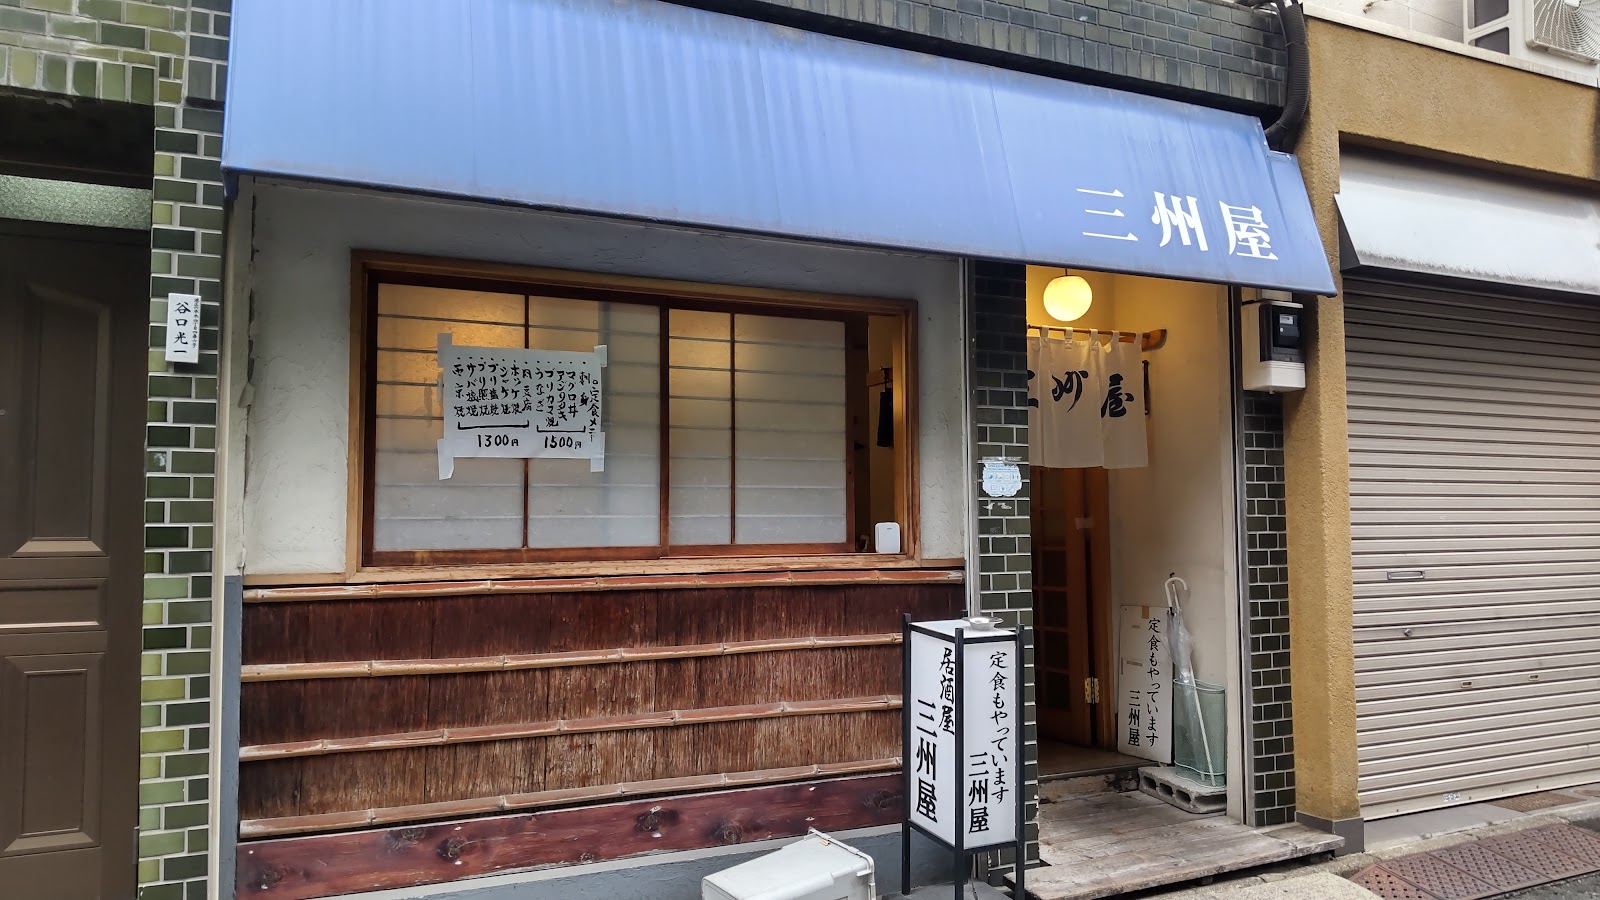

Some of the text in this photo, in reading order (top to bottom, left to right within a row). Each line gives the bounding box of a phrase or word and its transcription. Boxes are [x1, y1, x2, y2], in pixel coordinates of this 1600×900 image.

[1076, 188, 1279, 261] 三州屋
[173, 301, 191, 354] 谷口光一
[535, 367, 545, 413] うなぎ
[579, 371, 590, 407] 刺身
[477, 433, 519, 448] 1300円
[544, 435, 582, 449] 1500円
[938, 647, 956, 736] 居酒屋
[1146, 617, 1161, 747] 定食もやっています
[989, 650, 1010, 805] 定食もやっています
[1127, 689, 1141, 748] 三州屋
[916, 698, 938, 824] 三州屋
[968, 751, 990, 835] 三州屋
